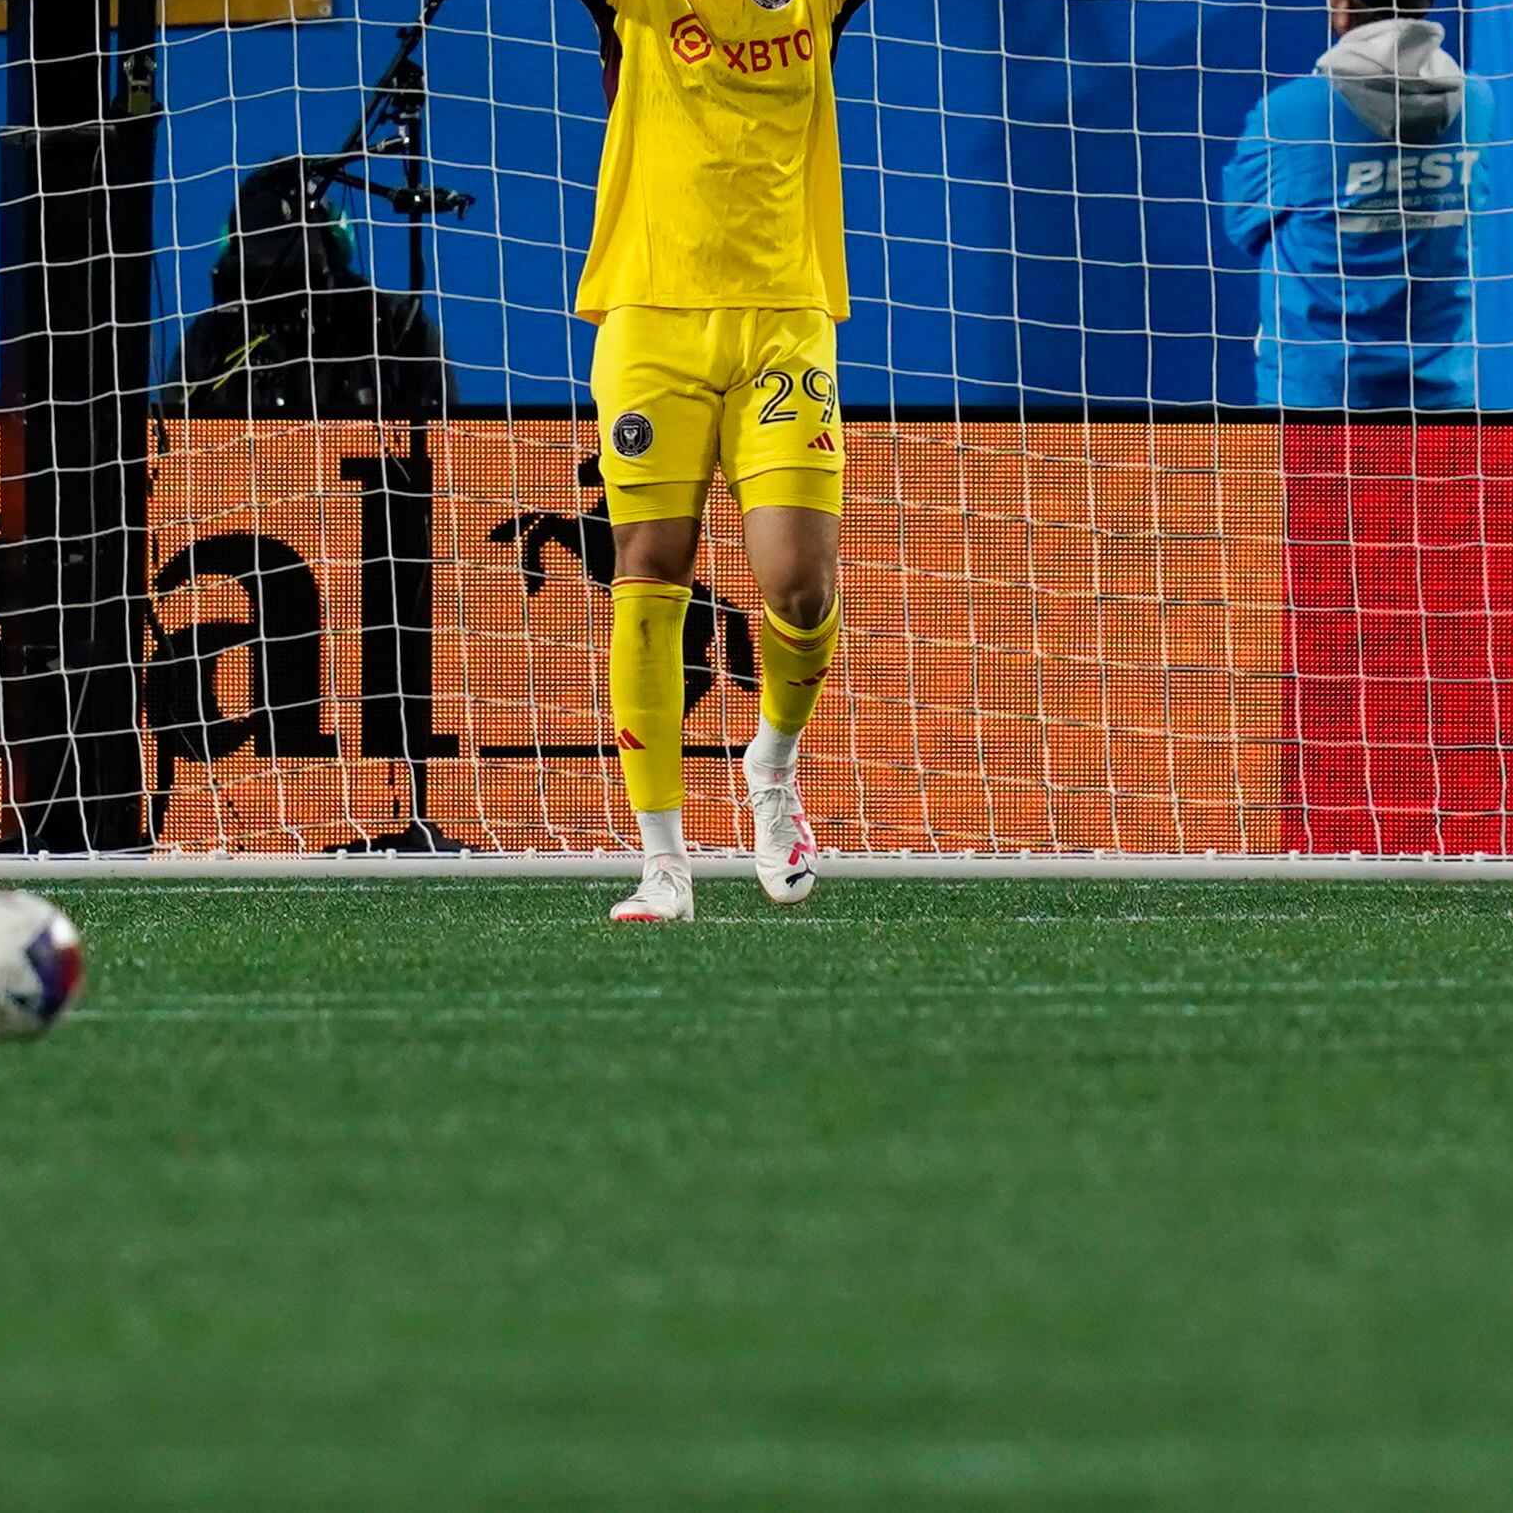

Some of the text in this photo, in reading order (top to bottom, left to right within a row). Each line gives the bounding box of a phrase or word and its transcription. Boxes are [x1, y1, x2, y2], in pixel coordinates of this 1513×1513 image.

[722, 29, 813, 74] XBTO
[1344, 149, 1481, 197] BEST
[754, 367, 836, 425] 29
